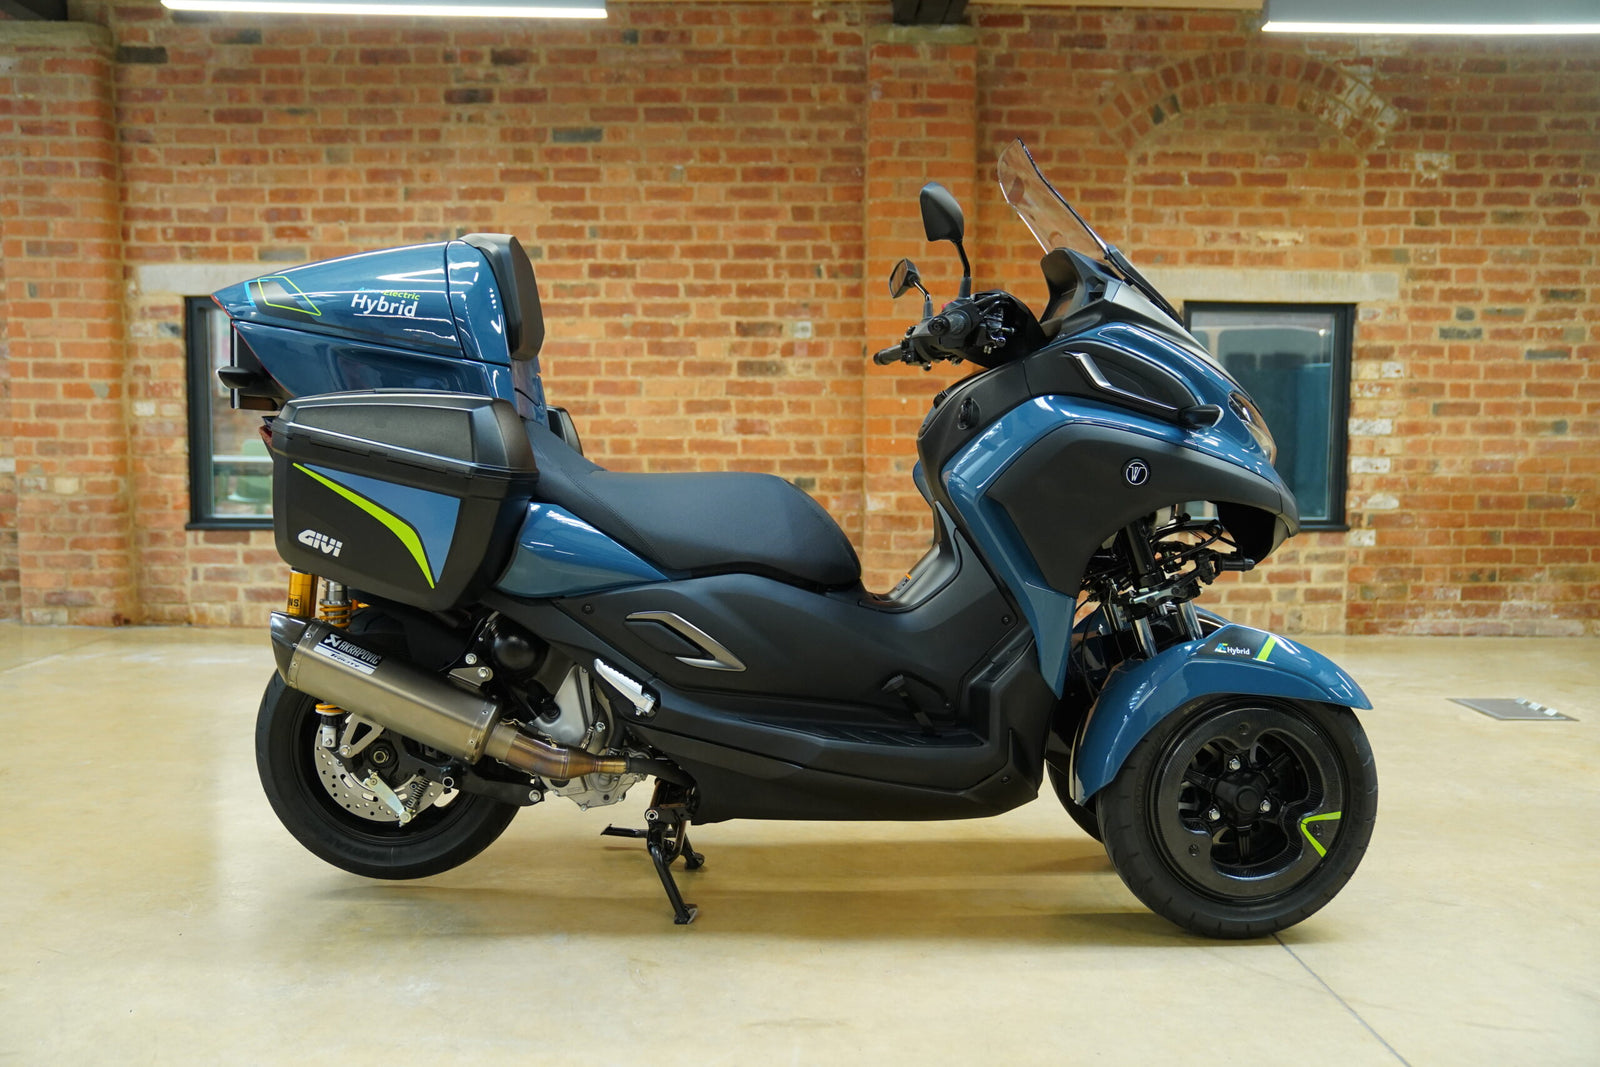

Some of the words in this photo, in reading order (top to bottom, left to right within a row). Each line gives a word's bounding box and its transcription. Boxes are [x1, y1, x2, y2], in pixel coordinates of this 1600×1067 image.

[351, 294, 418, 317] Hybrid
[298, 530, 343, 557] GIVI
[1227, 647, 1250, 655] Hybrid
